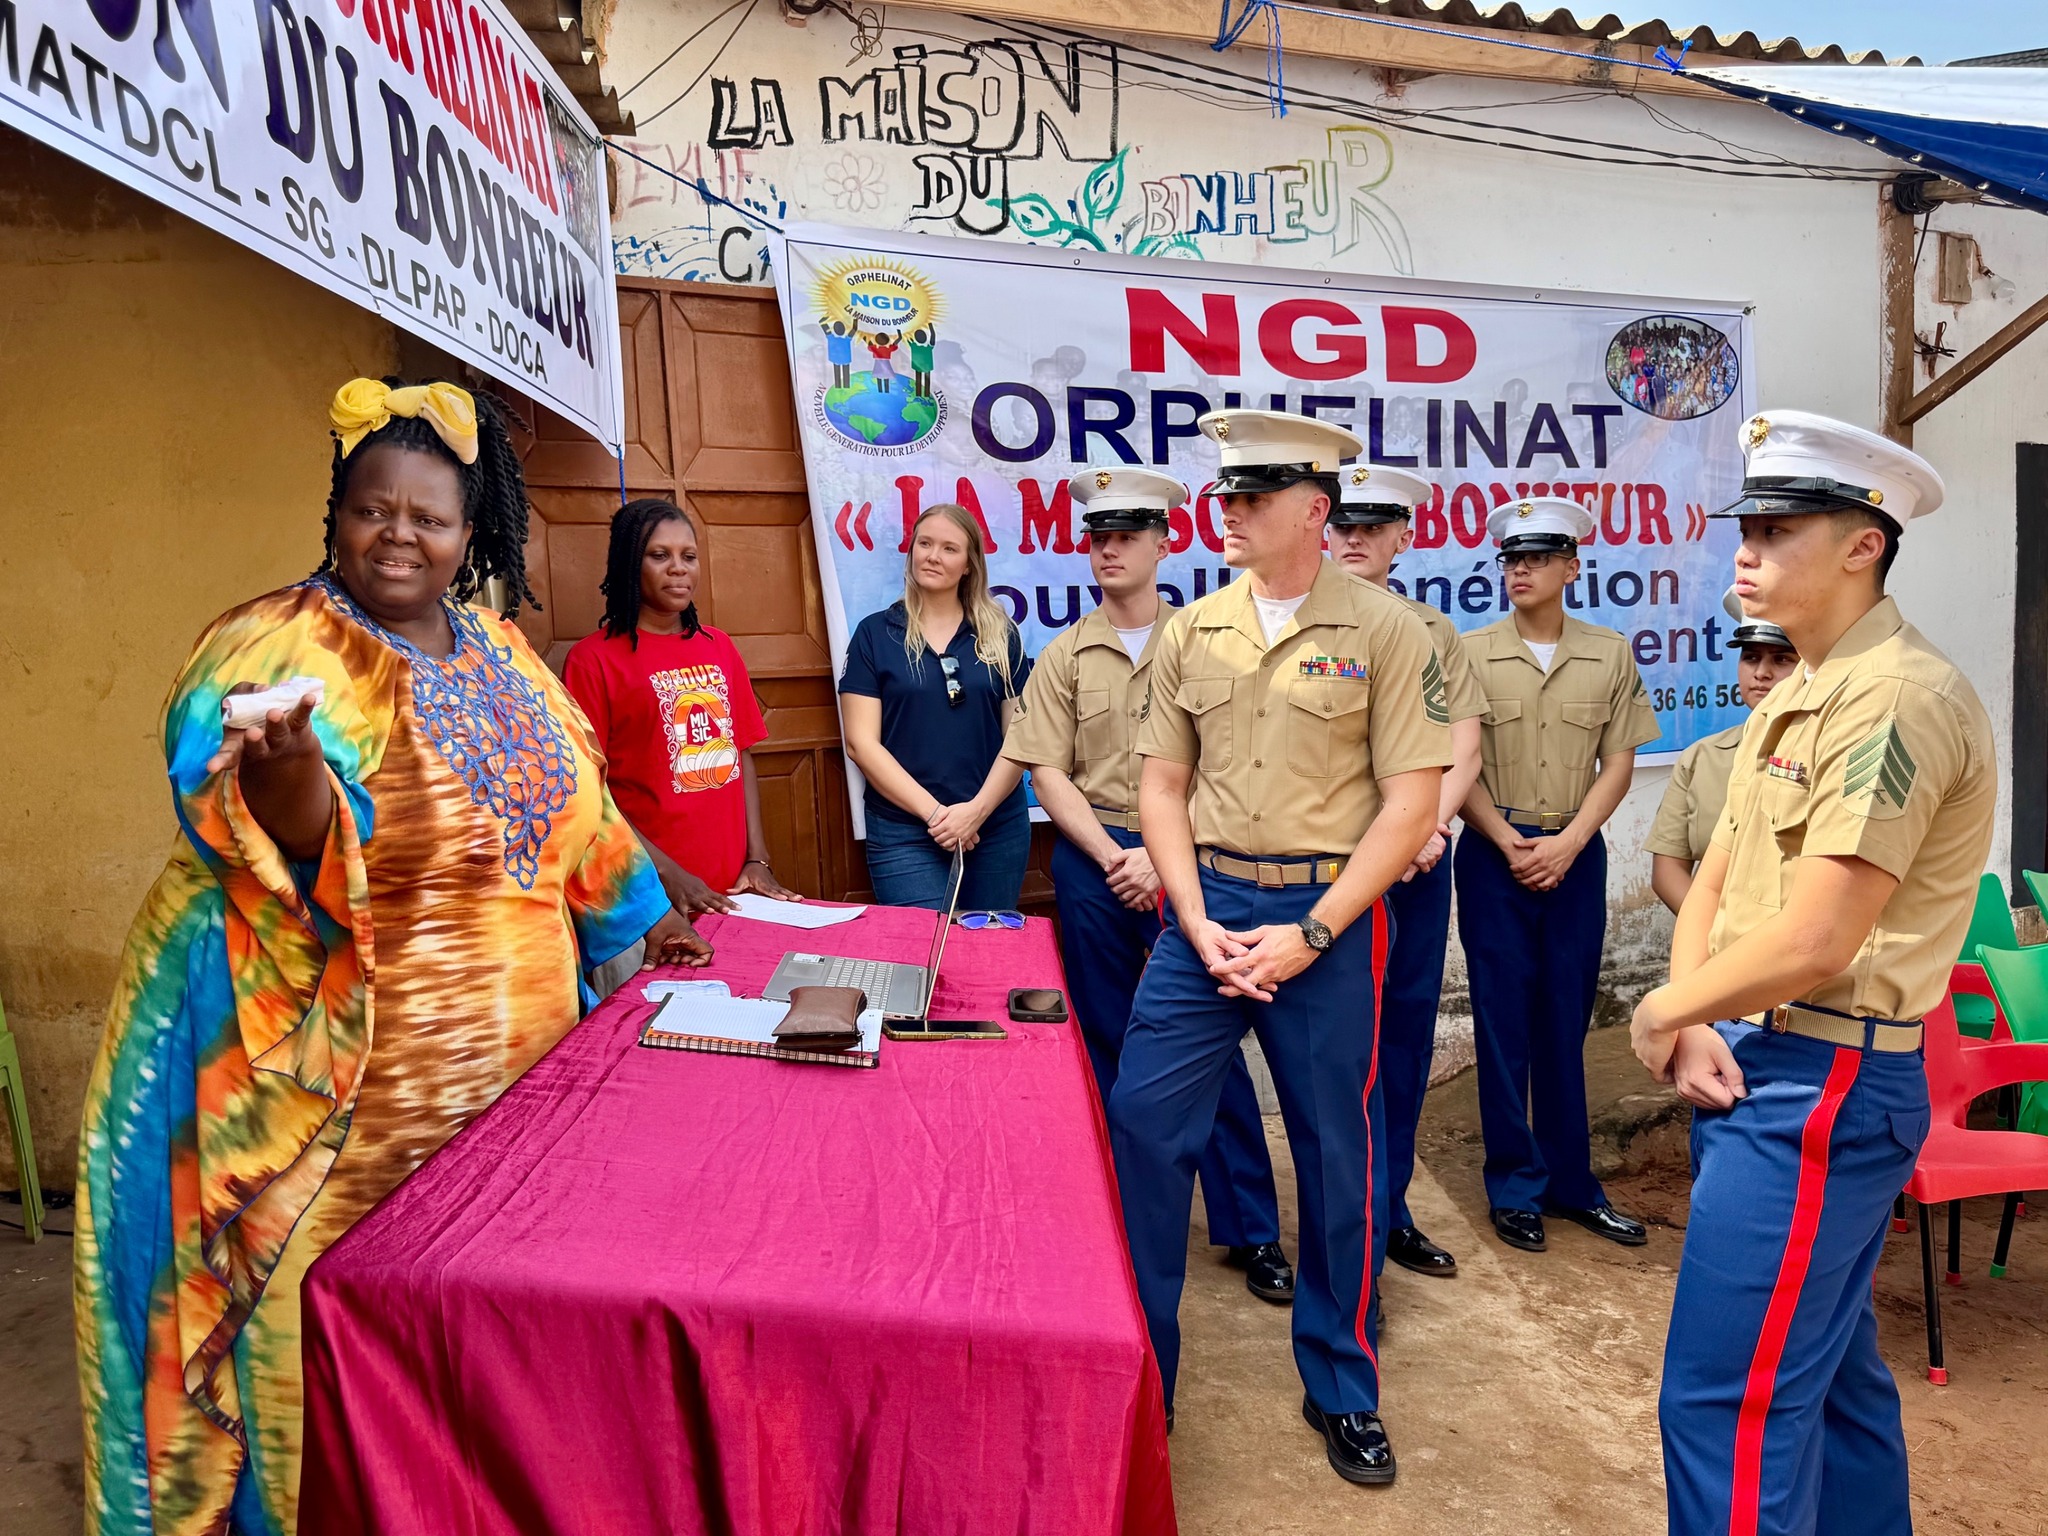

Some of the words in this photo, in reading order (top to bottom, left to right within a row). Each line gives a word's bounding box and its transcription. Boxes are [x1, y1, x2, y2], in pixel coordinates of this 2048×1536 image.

[706, 75, 795, 151] LA
[257, 0, 364, 204] DU
[378, 78, 595, 370] BONHEUR
[908, 150, 1009, 236] DU
[281, 176, 336, 260] SG
[360, 232, 468, 332] DLPAP
[487, 307, 549, 385] DOCA
[846, 272, 912, 291] ORPHELINAT
[843, 304, 854, 316] LA
[852, 311, 880, 326] MAISON
[881, 318, 892, 327] DU
[892, 307, 920, 326] BONHEUR
[850, 292, 912, 311] NGD
[1125, 286, 1478, 384] NGD
[813, 382, 831, 431] NOUVELLE
[880, 446, 905, 458] POUR
[905, 444, 917, 456] LE
[669, 664, 723, 691] LOVE
[1652, 687, 1677, 712] 36
[1682, 685, 1708, 709] 46
[1714, 683, 1746, 708] 56
[689, 711, 709, 728] MU
[691, 726, 713, 742] SIC
